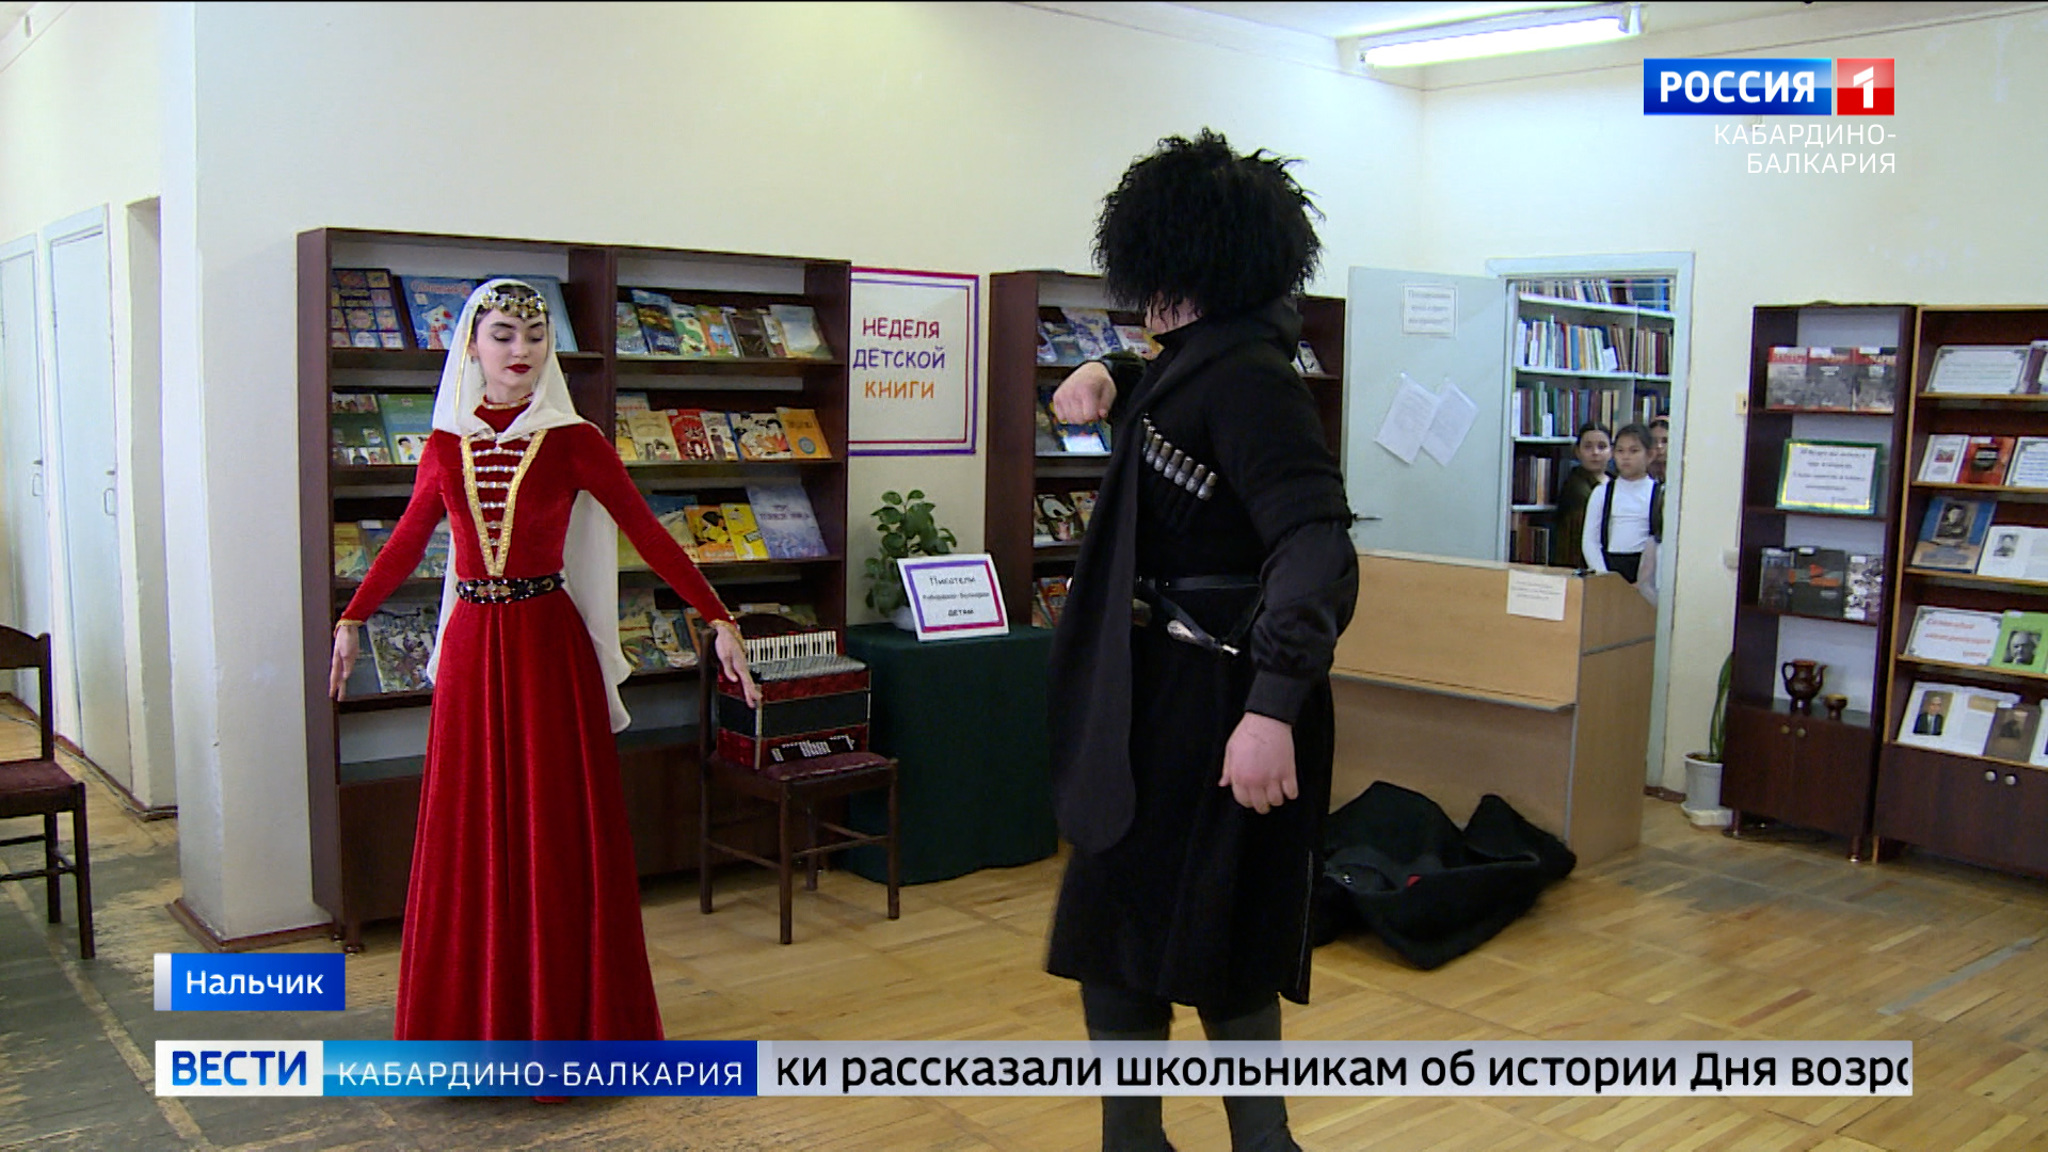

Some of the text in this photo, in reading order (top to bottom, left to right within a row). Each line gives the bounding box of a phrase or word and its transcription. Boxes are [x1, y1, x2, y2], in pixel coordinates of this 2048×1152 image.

[862, 317, 940, 340] НЕДЕЛЯ
[852, 345, 946, 370] ДЕТСКОЙ
[865, 380, 935, 399] КНИГИ
